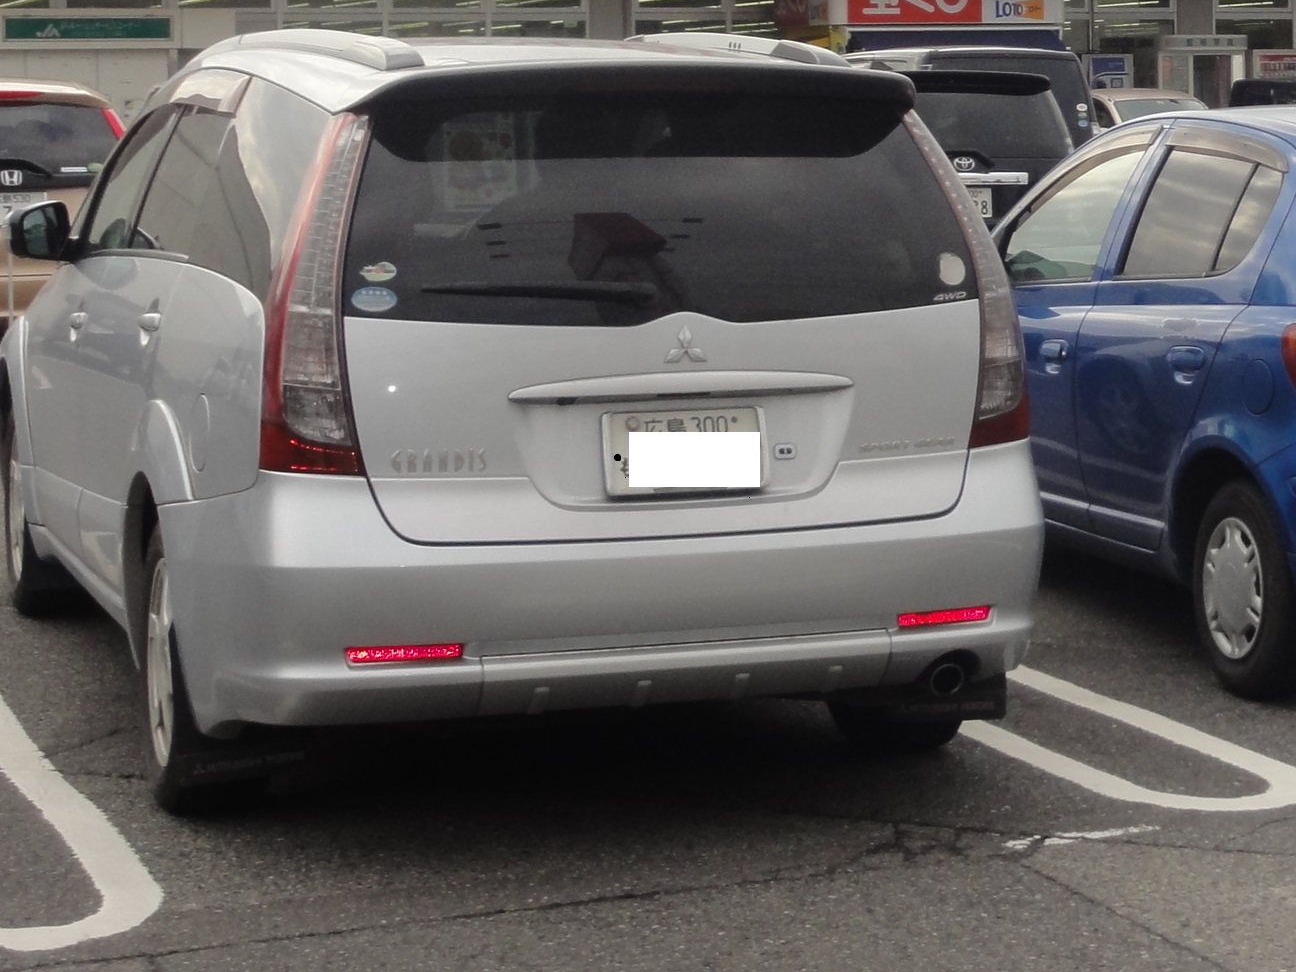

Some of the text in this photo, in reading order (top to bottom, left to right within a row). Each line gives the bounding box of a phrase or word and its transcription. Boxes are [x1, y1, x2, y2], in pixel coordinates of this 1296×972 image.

[995, 0, 1023, 18] LOTO
[933, 291, 967, 301] 4WD
[391, 448, 487, 473] GRANDIS
